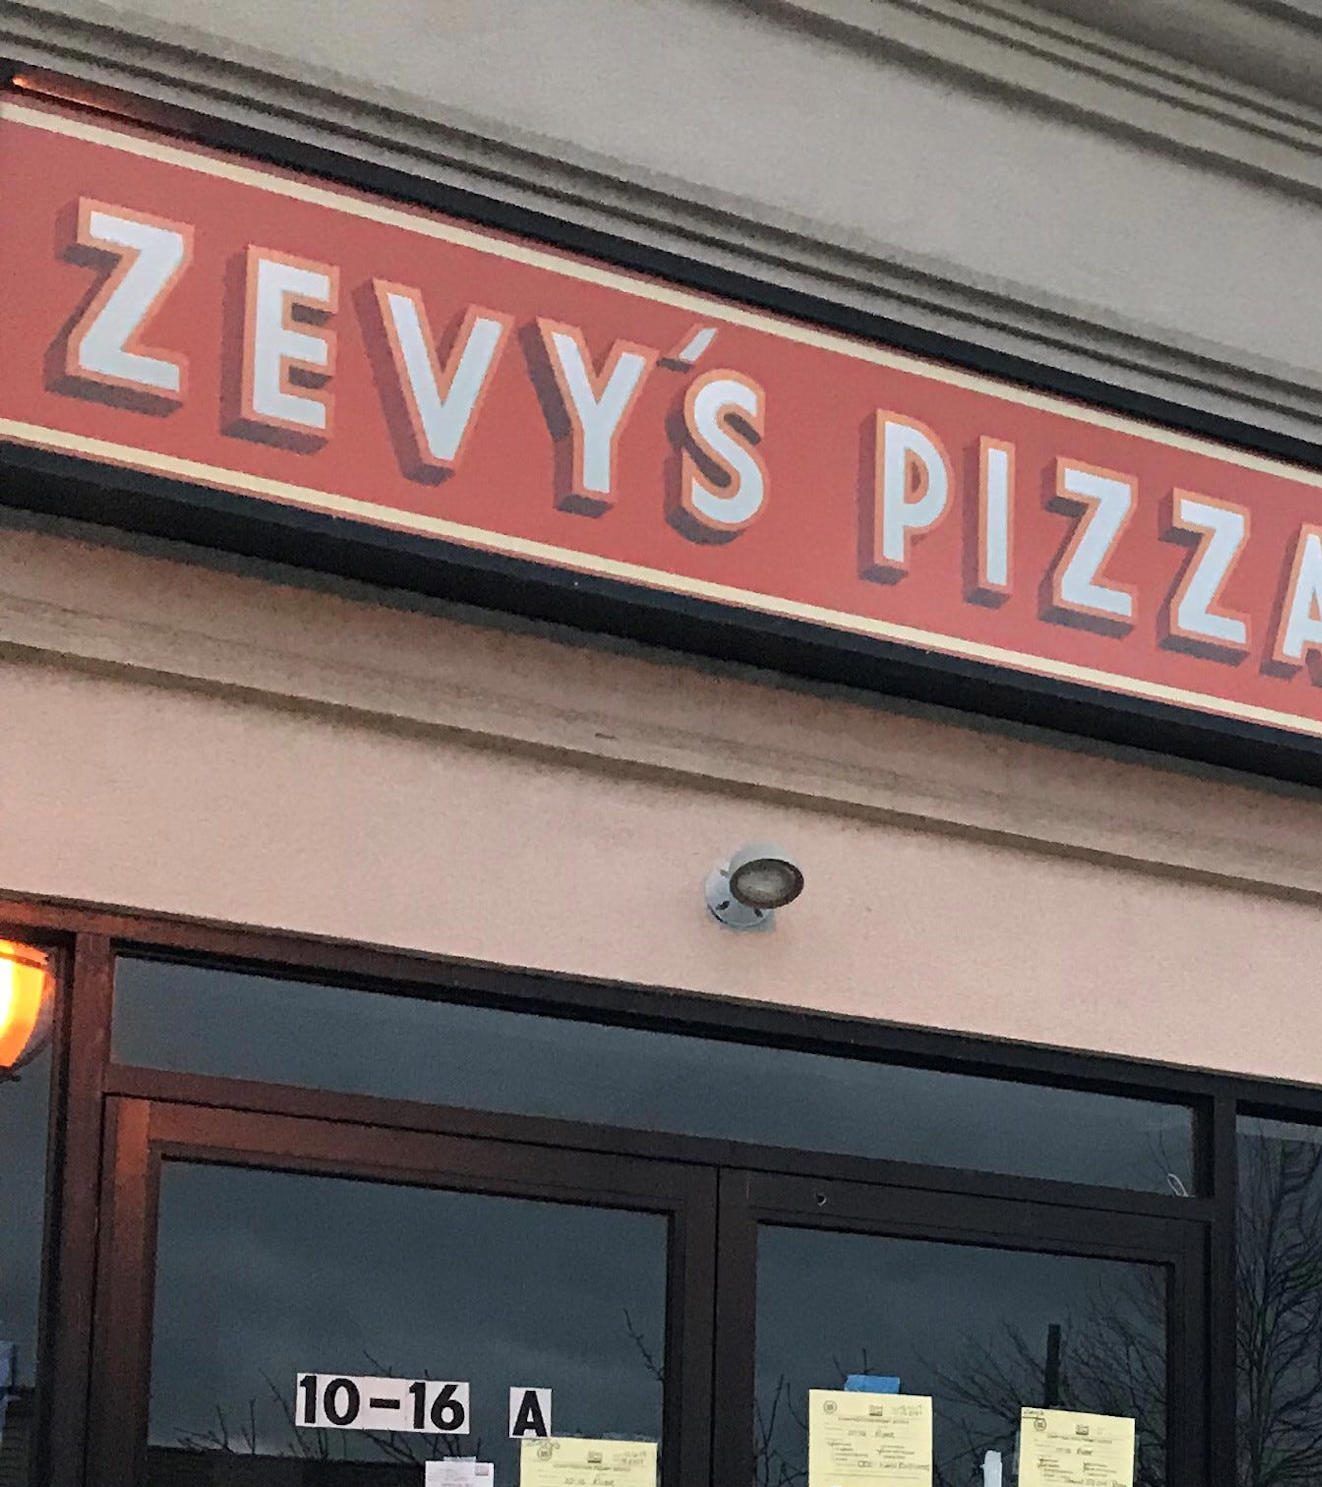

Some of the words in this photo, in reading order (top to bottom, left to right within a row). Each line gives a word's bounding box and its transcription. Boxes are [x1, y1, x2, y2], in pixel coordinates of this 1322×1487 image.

[54, 197, 768, 540] ZEVY'S
[300, 1375, 466, 1431] 10-16
[512, 1391, 548, 1438] A
